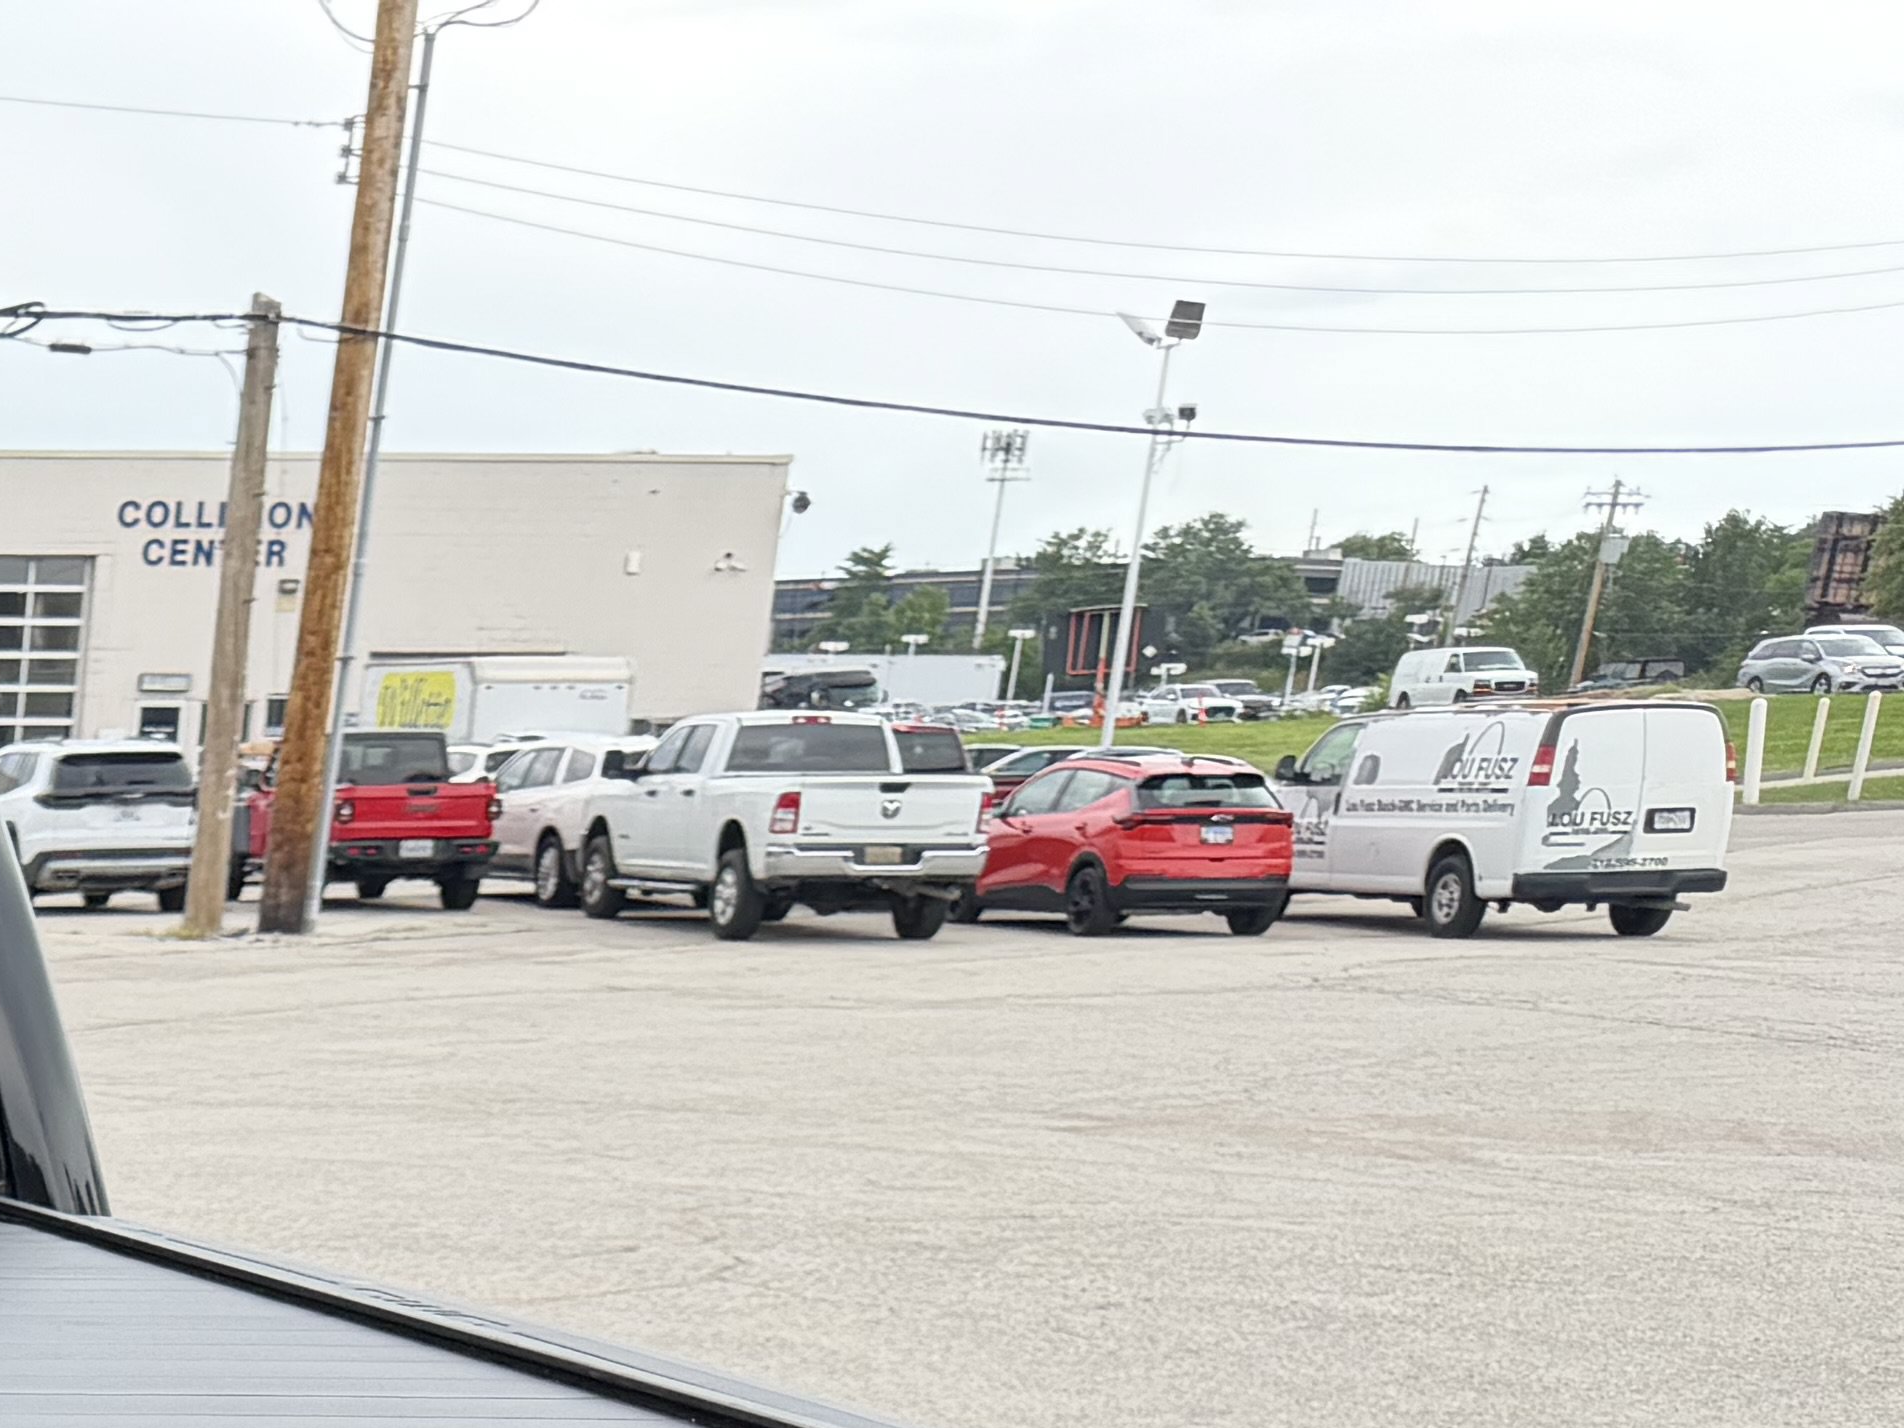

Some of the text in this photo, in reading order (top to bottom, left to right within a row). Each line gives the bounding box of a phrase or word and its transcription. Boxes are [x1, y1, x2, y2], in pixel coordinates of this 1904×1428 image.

[118, 500, 314, 529] COLLION
[143, 538, 286, 567] CENR
[1475, 757, 1519, 779] FUSZ
[1550, 810, 1633, 827] LOU FUSZ
